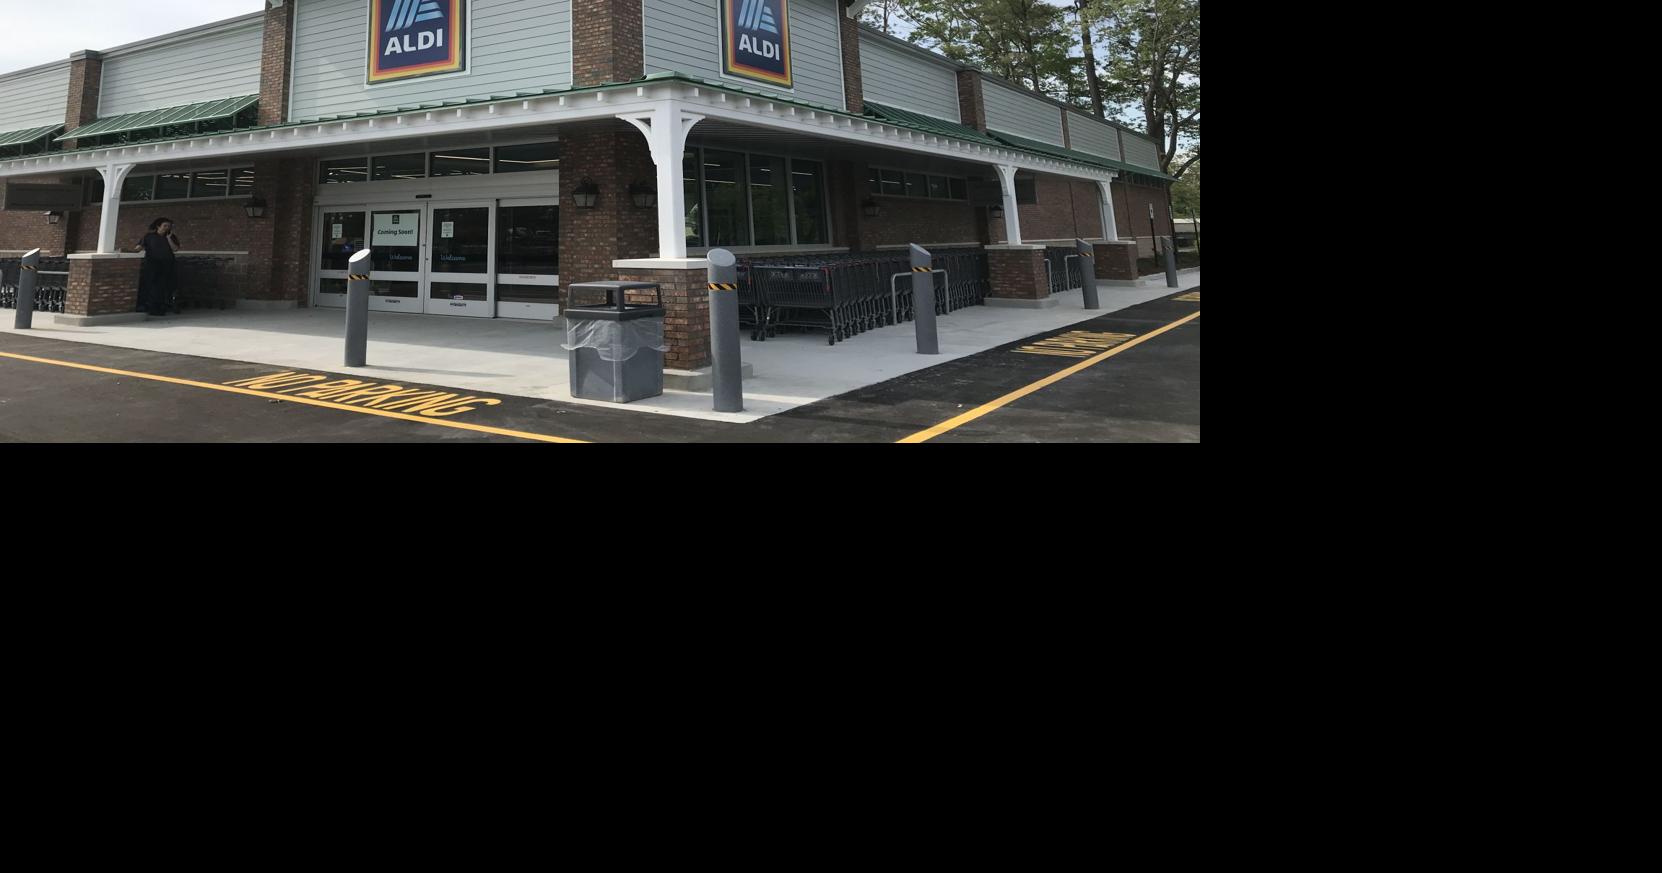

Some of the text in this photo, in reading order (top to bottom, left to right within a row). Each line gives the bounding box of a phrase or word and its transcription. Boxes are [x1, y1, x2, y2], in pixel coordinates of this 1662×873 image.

[384, 28, 444, 56] ALDI
[738, 33, 780, 61] ALDI
[222, 371, 502, 417] NO PARKING
